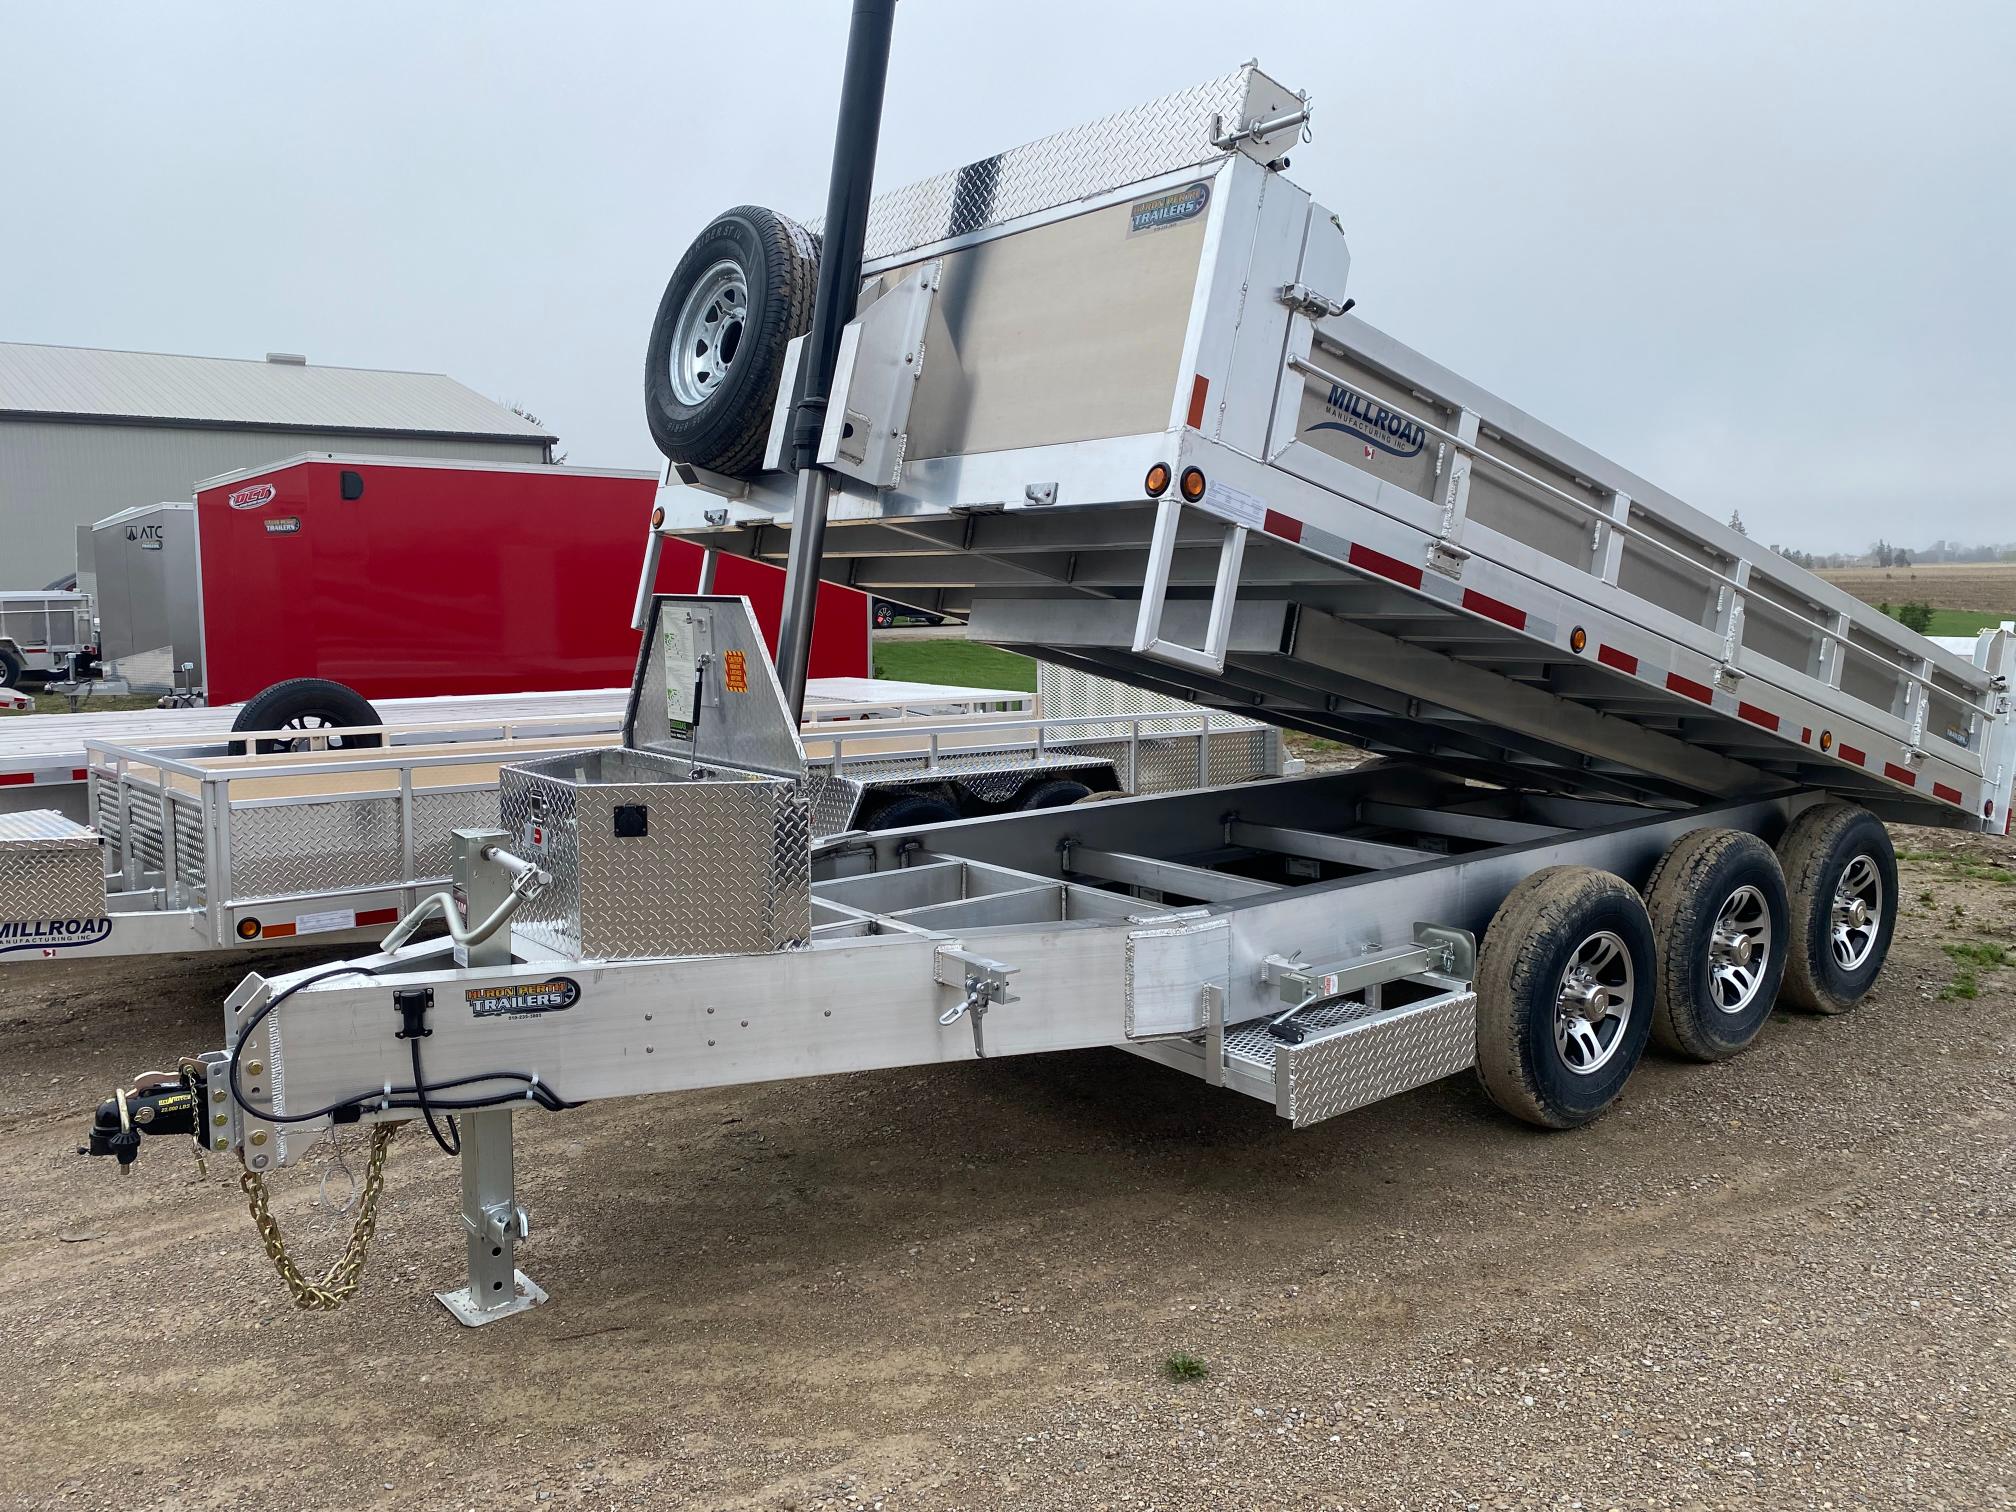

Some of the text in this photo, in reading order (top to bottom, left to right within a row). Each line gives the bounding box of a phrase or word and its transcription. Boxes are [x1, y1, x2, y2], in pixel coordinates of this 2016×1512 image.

[1135, 201, 1195, 225] TRAILERS
[1327, 384, 1425, 447] MILLROAD
[1325, 406, 1406, 451] MANUFACTURING INC
[140, 525, 163, 539] ATC
[266, 524, 296, 532] TRAILERS
[0, 935, 73, 945] ANUFACTURING
[467, 982, 567, 1000] HURON PERTH
[473, 993, 561, 1011] TRAILERS
